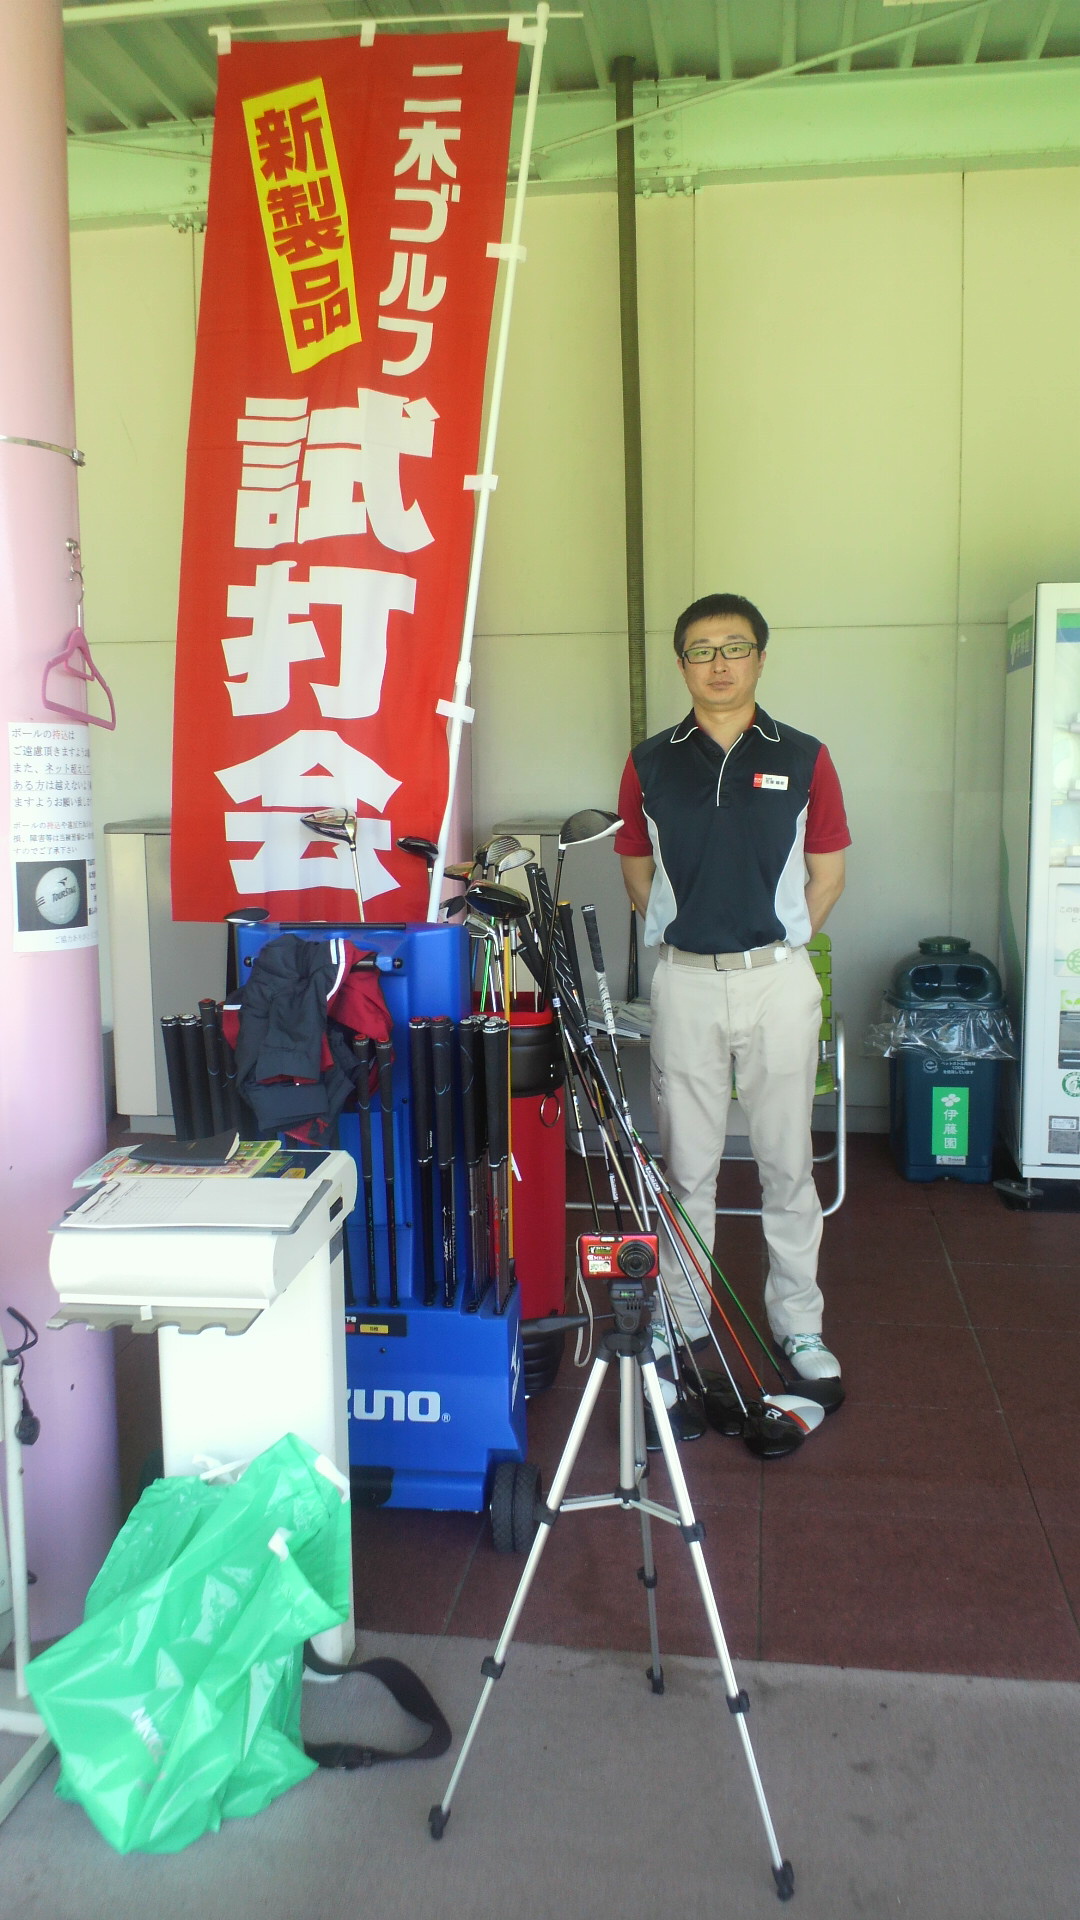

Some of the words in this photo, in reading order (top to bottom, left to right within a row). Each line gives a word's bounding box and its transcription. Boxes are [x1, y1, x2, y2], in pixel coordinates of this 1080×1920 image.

[255, 97, 352, 350] 新製品
[378, 63, 464, 377] 二木ゴルフ
[213, 387, 440, 899] 試打会
[943, 1109, 959, 1149] 伊藤園
